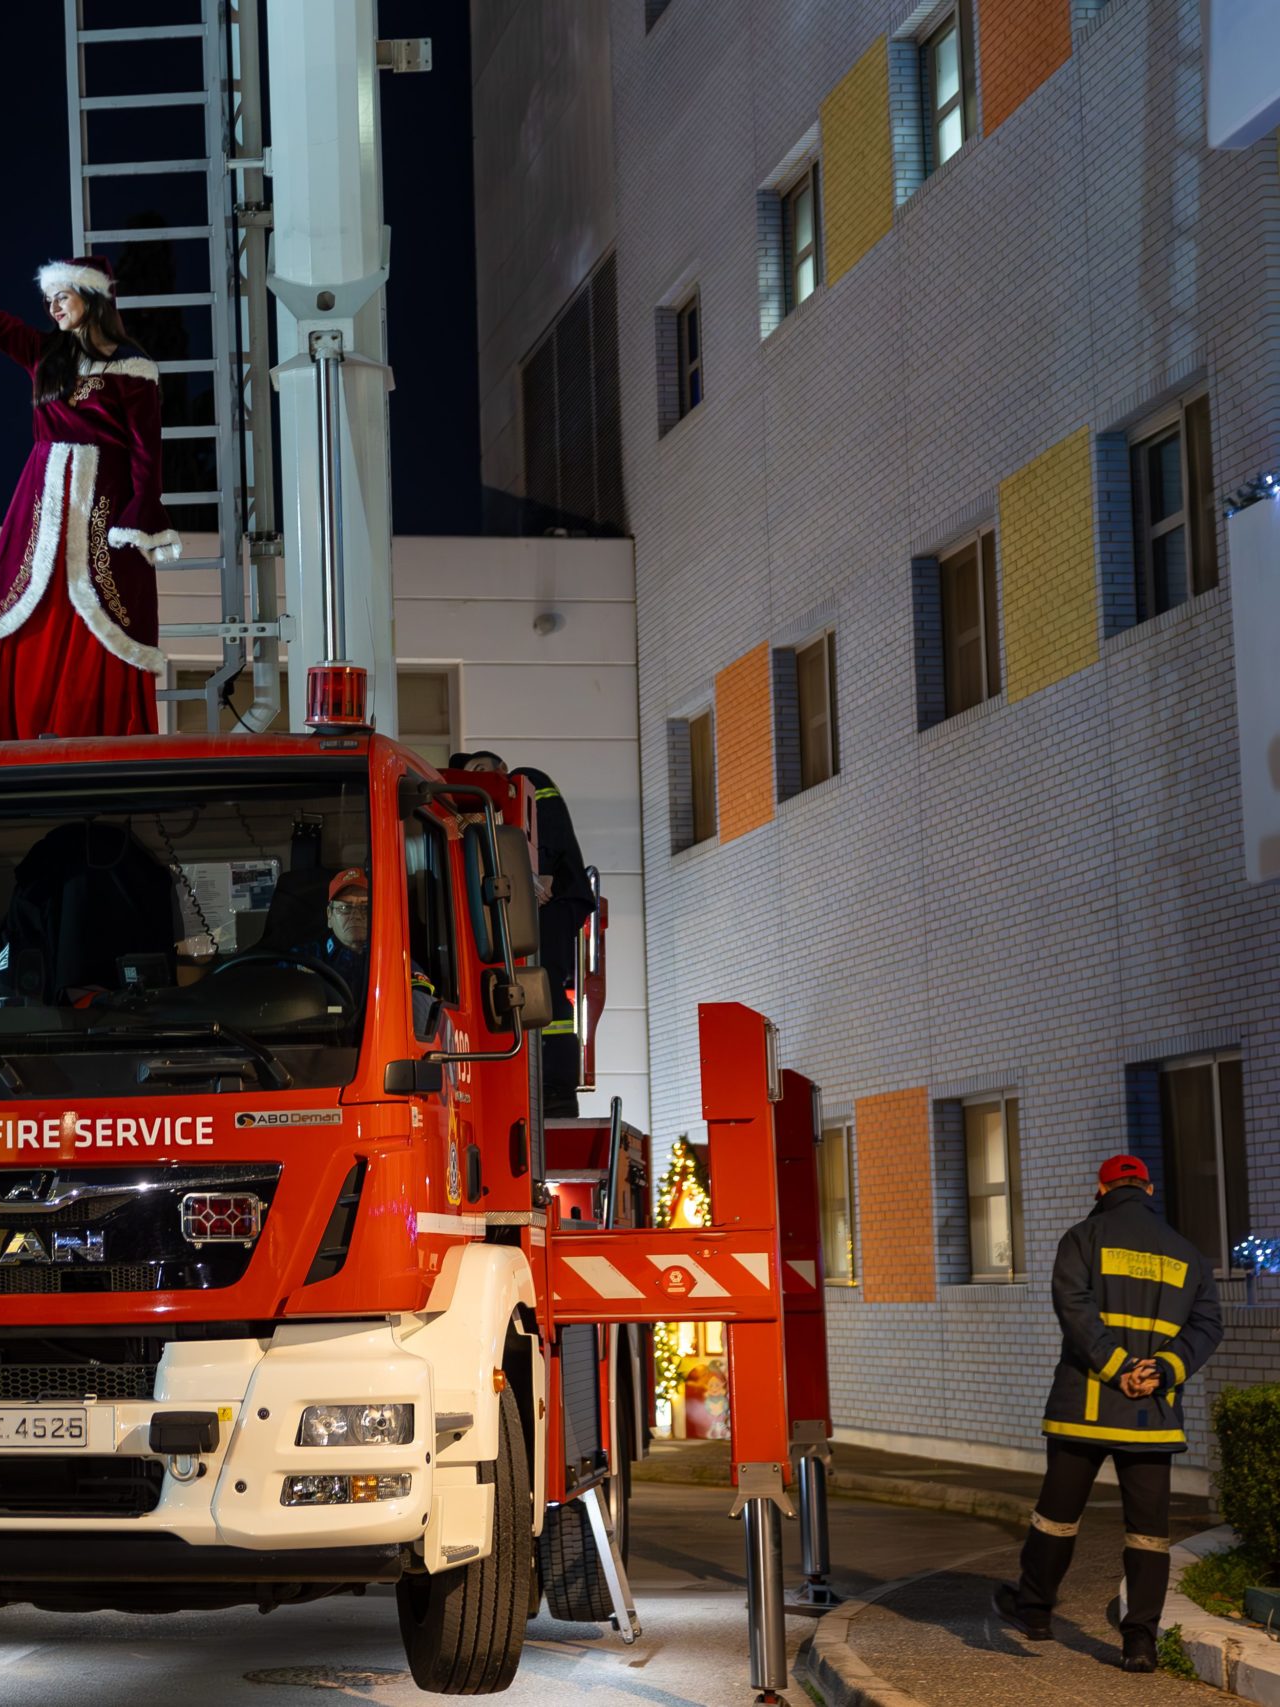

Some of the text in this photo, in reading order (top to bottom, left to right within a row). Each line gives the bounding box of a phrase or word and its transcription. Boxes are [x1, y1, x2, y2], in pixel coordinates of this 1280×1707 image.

[257, 1112, 341, 1124] ABO Deman
[74, 1116, 214, 1148] SERVICE
[15, 1417, 83, 1439] 4525
